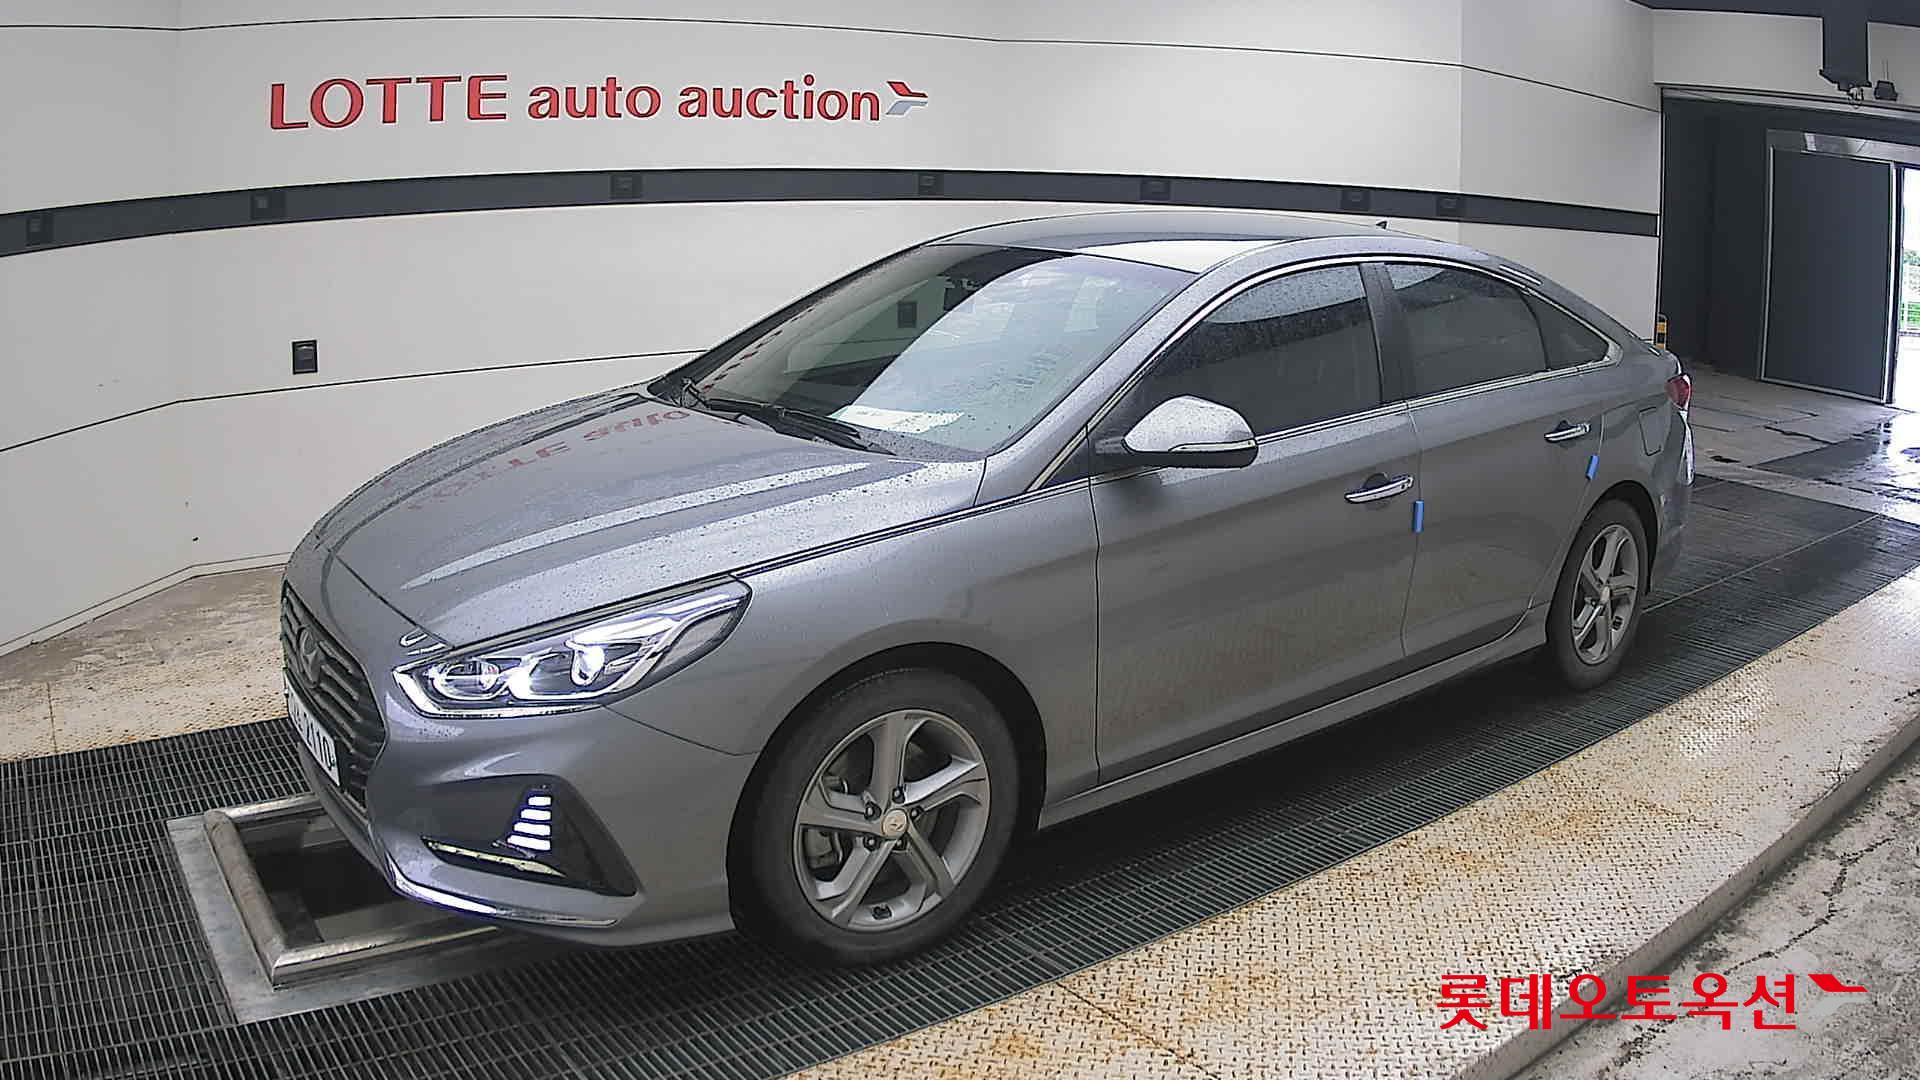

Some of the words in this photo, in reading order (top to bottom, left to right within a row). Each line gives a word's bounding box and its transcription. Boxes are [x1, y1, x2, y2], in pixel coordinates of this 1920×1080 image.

[269, 74, 507, 130] LOTTE
[527, 76, 661, 120] auto
[677, 75, 881, 121] auction
